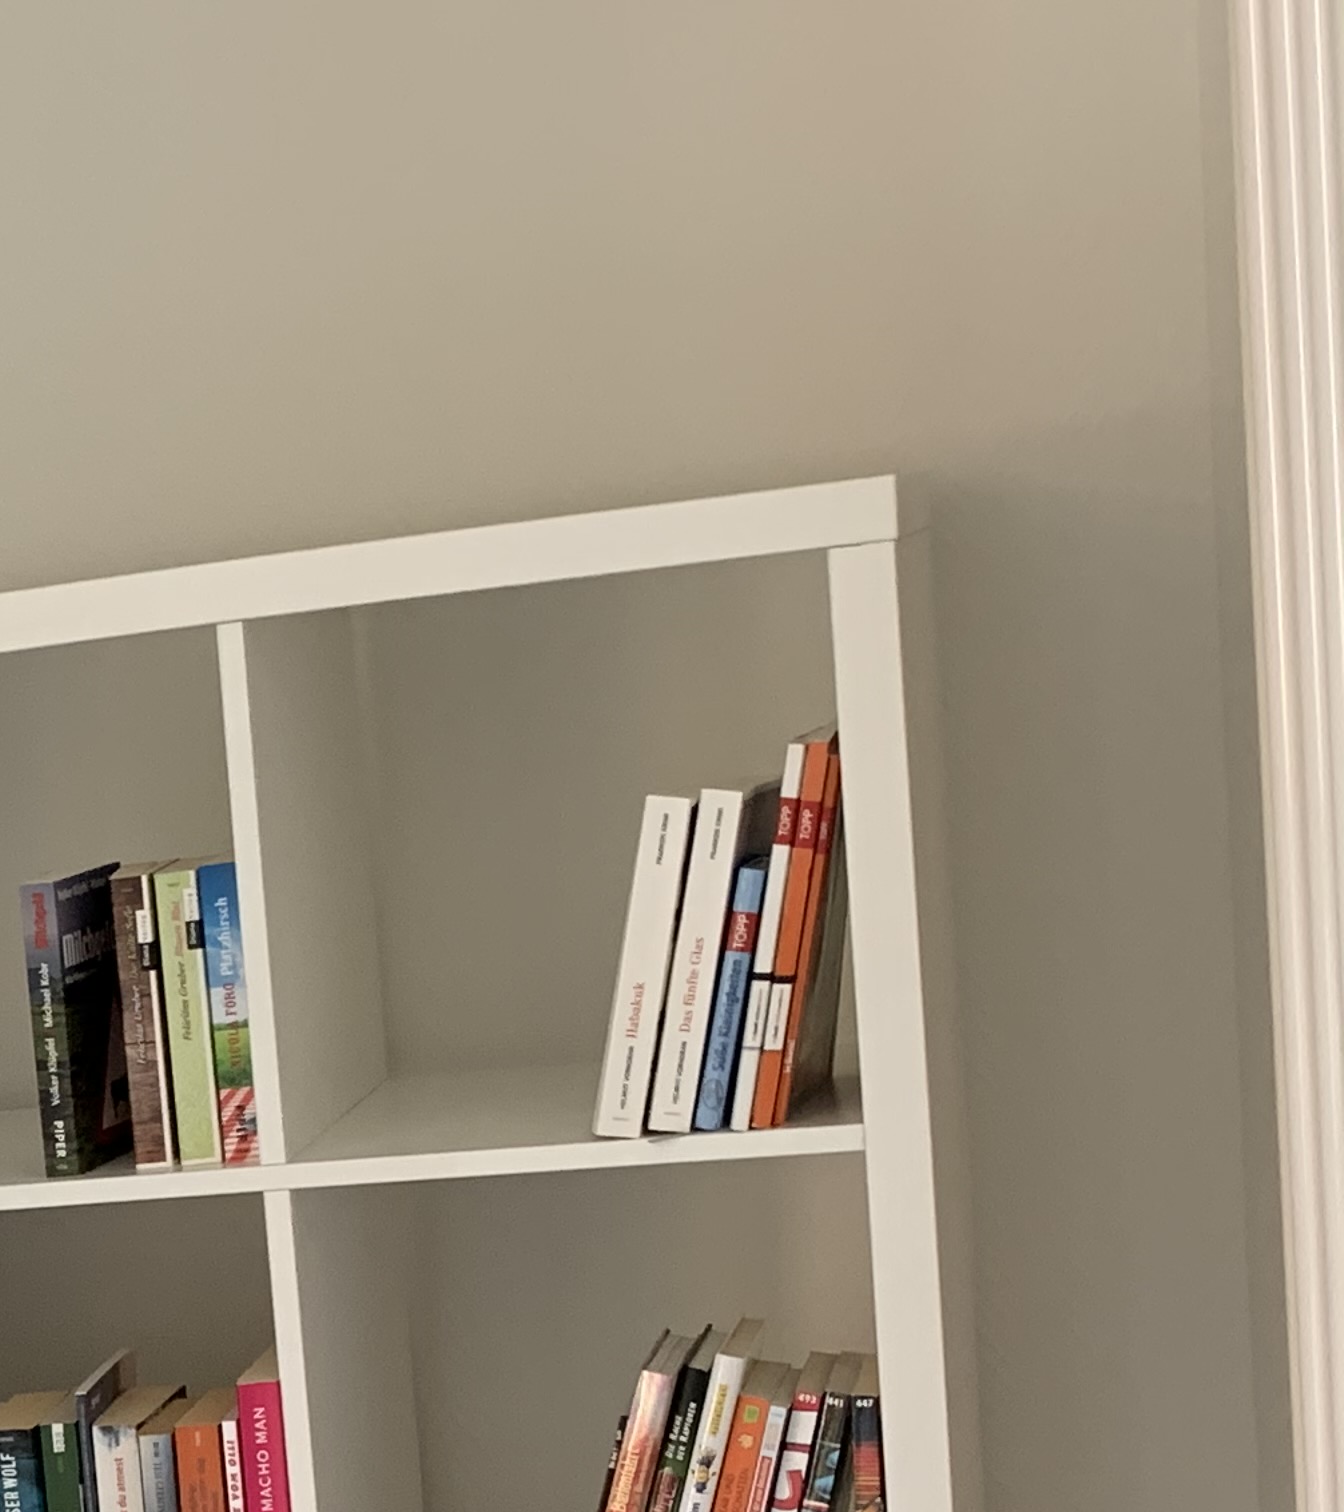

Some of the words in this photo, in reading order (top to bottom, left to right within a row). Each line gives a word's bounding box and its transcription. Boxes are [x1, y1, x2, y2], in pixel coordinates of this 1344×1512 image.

[777, 804, 793, 837] TOPP
[799, 808, 814, 840] TOPP
[214, 896, 231, 977] Platzhirsch
[732, 913, 749, 950] TOPP
[691, 936, 705, 968] Glas
[38, 961, 49, 990] Kobr
[176, 960, 190, 998] Gruber
[683, 971, 700, 1009] fünfte
[43, 990, 54, 1029] Michael
[624, 980, 646, 1040] Habakuk
[717, 958, 743, 1040] Kleinigkeiten
[678, 1012, 693, 1034] Das
[50, 1073, 62, 1107] Volker
[55, 1120, 65, 1159] PIPER
[252, 1406, 268, 1445] MAN
[0, 1451, 16, 1489] WOLF
[226, 1439, 237, 1468] OLLI
[113, 1457, 126, 1493] atmest
[229, 1471, 240, 1502] VOM
[255, 1449, 274, 1512] MACHO
[116, 1493, 127, 1508] du
